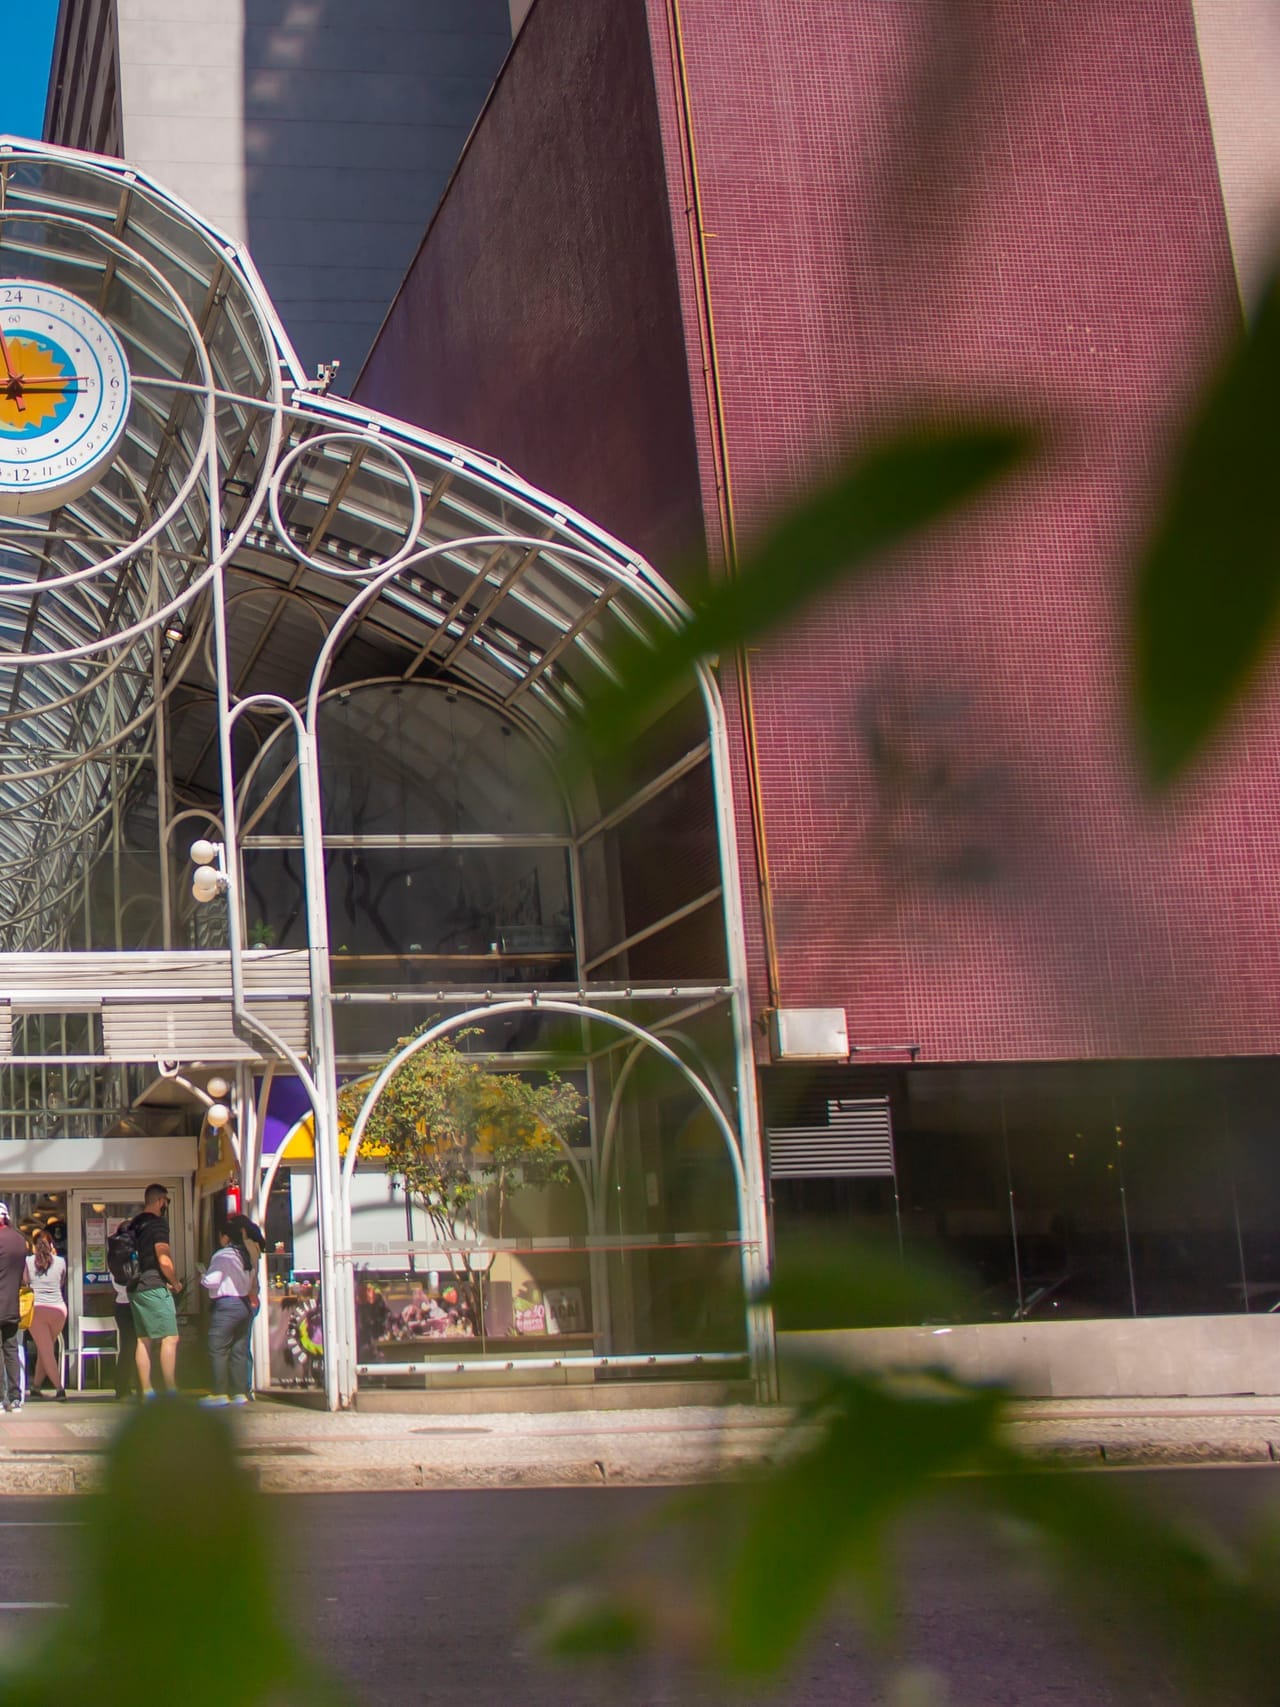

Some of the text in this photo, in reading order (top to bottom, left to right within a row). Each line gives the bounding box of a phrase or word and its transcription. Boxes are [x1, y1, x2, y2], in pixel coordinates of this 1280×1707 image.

[5, 290, 23, 303] 24
[60, 303, 65, 312] 2
[9, 314, 21, 323] 60
[96, 335, 102, 343] 4
[108, 355, 113, 364] 5
[85, 378, 95, 387] 15
[110, 376, 120, 388] 6
[110, 401, 116, 410] 7
[101, 423, 108, 432] 8
[87, 441, 93, 450] 9
[16, 447, 27, 455] 30
[65, 457, 77, 466] 10
[15, 468, 30, 481] 12
[42, 466, 52, 476] 11
